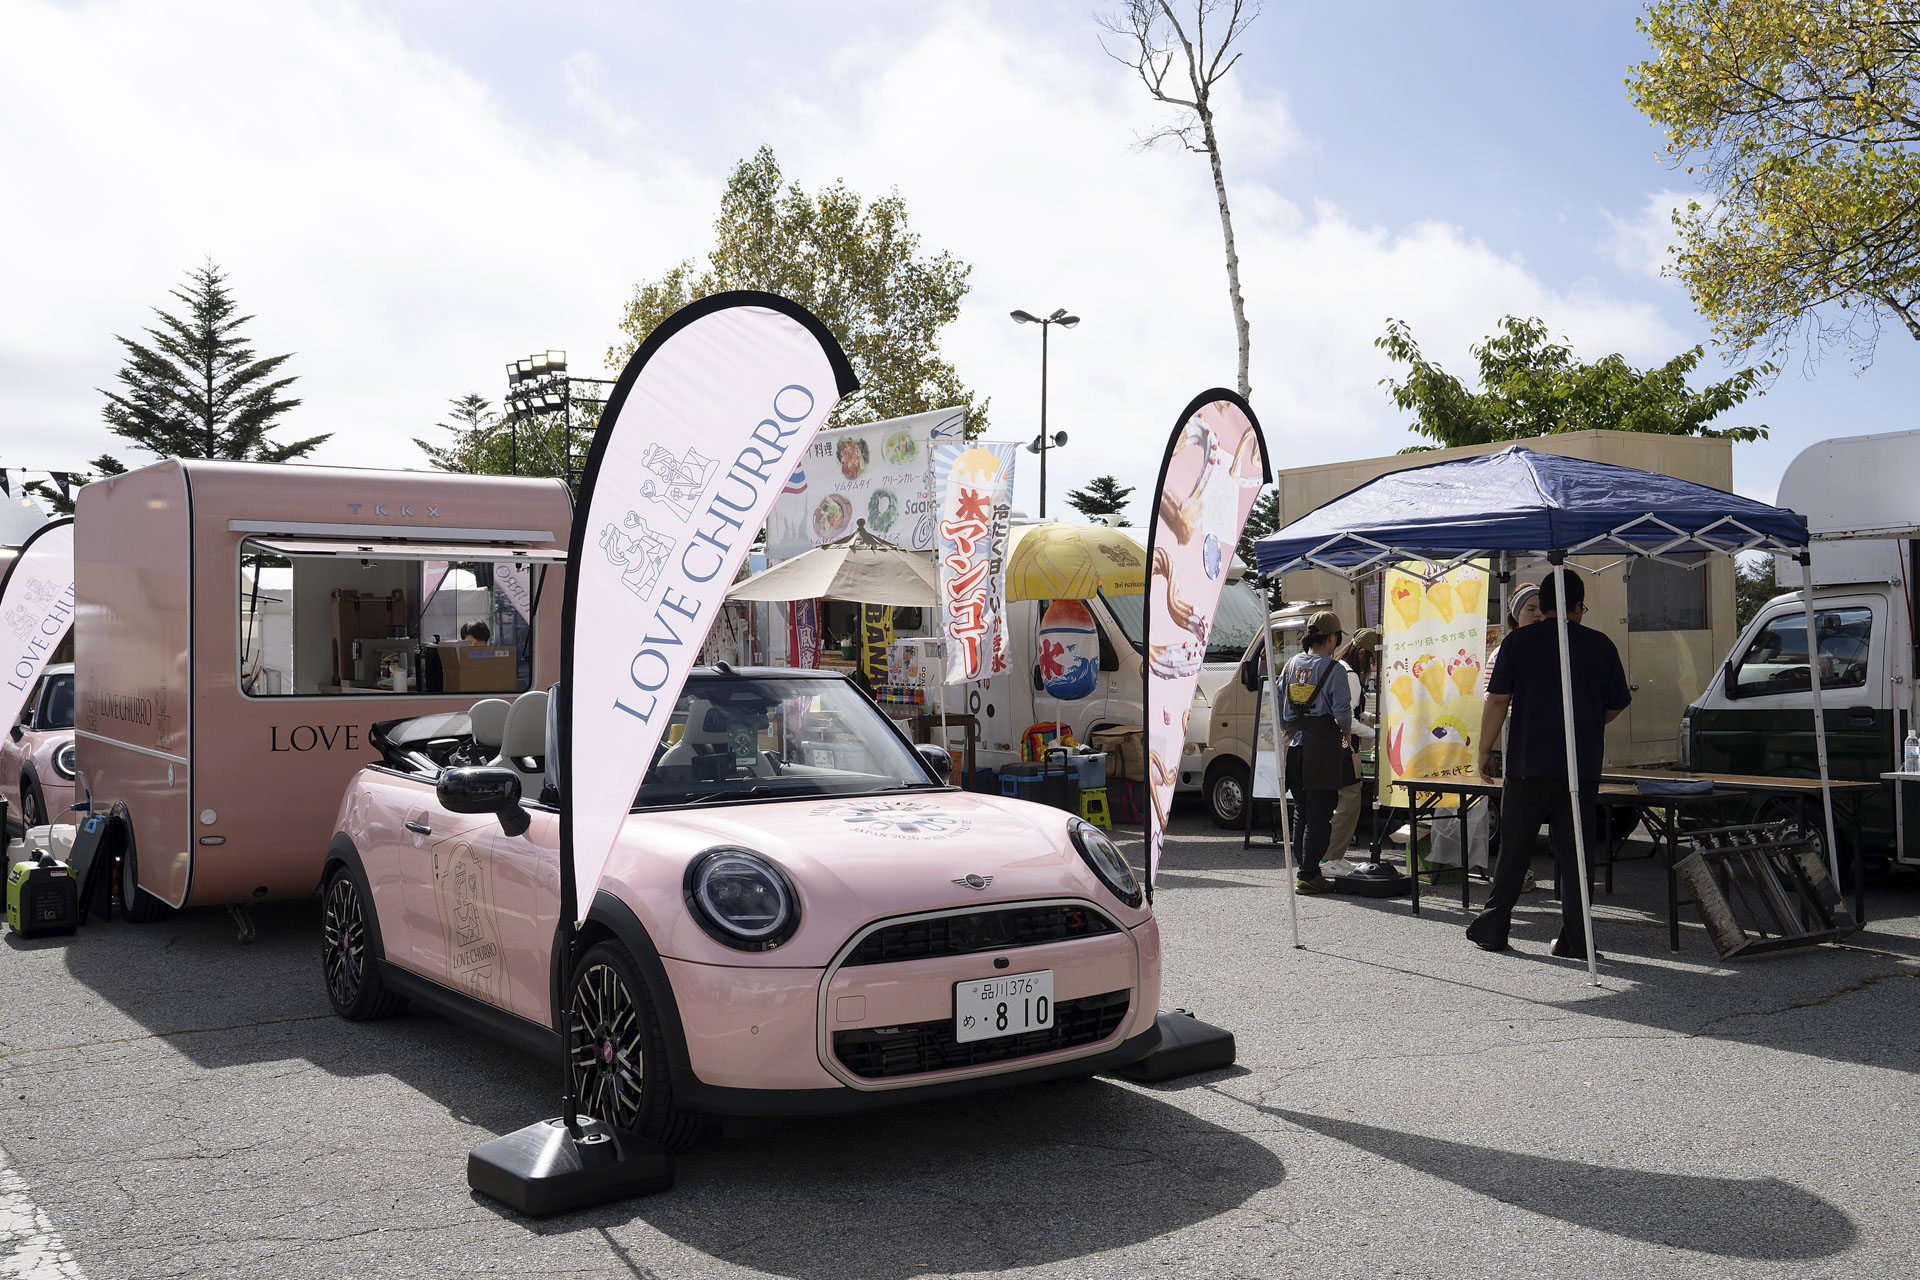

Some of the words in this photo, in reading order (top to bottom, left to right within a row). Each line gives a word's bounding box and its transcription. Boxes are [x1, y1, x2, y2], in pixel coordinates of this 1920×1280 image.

[834, 478, 872, 492] ソムタムタイ
[882, 472, 922, 485] グリーンカレー
[612, 586, 702, 725] LOVE
[681, 384, 815, 583] CHURRO
[940, 518, 989, 680] マンゴー
[7, 635, 50, 692] LOVE
[101, 690, 119, 719] LOVE
[119, 694, 152, 727] CHURRO
[269, 724, 360, 752] LOVE
[453, 951, 471, 969] LOVE
[470, 942, 497, 964] CHURRO
